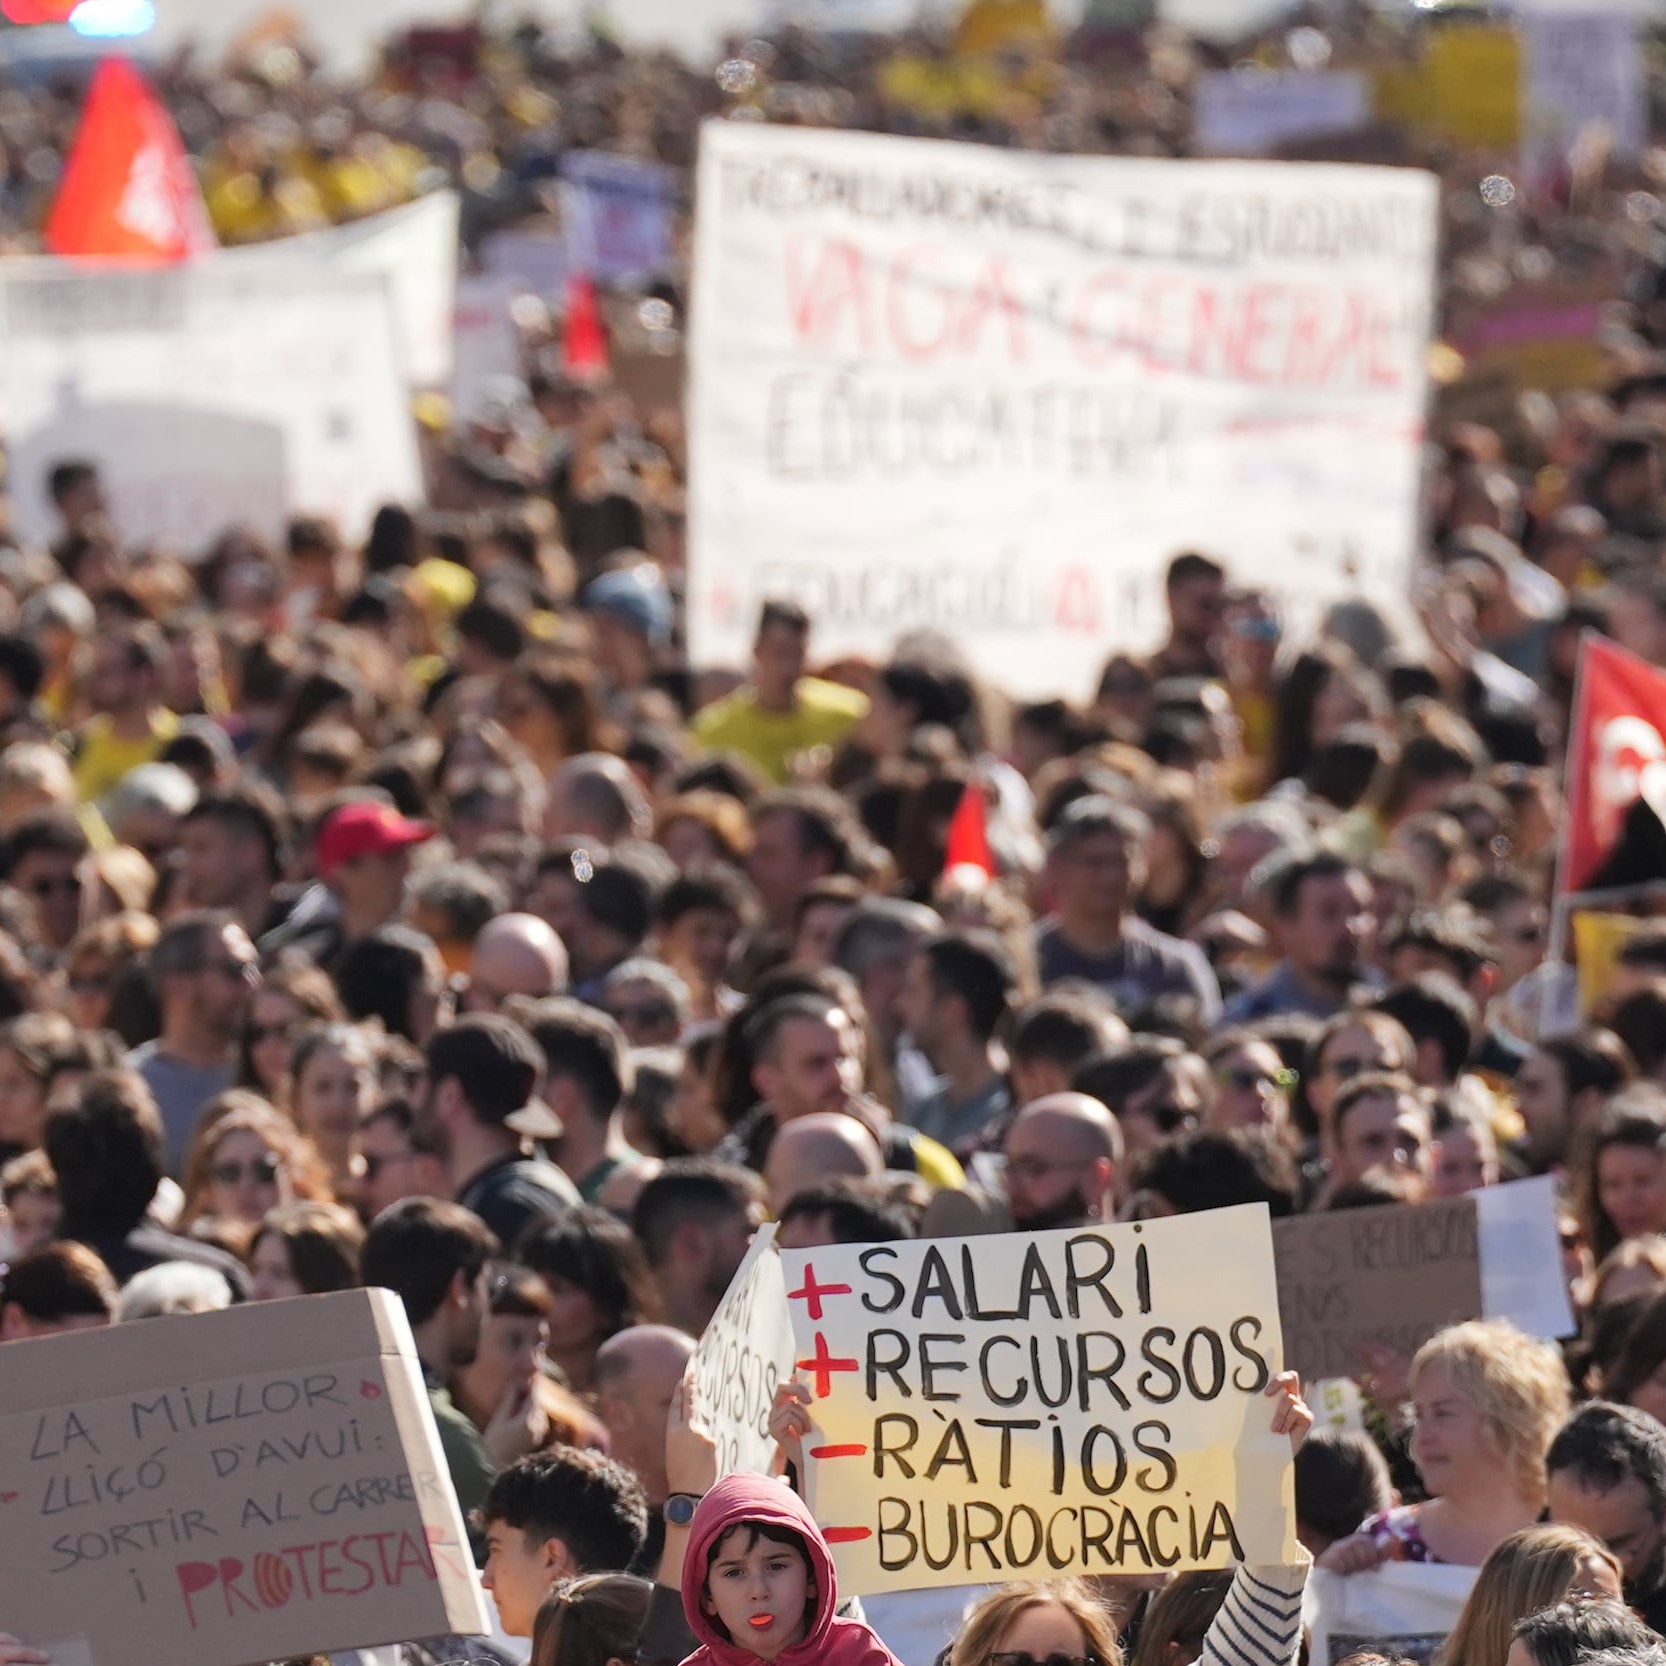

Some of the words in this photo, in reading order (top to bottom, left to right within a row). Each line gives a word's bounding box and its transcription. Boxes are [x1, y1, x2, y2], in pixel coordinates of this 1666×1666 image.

[865, 1315, 1270, 1413] RECURSOS
[30, 1411, 101, 1461] LA
[132, 1374, 346, 1442] MILLOR
[48, 1508, 219, 1572] SORTIR
[240, 1498, 301, 1528] AL
[309, 1469, 443, 1517] CARRER
[176, 1524, 464, 1629] PROTESTAR
